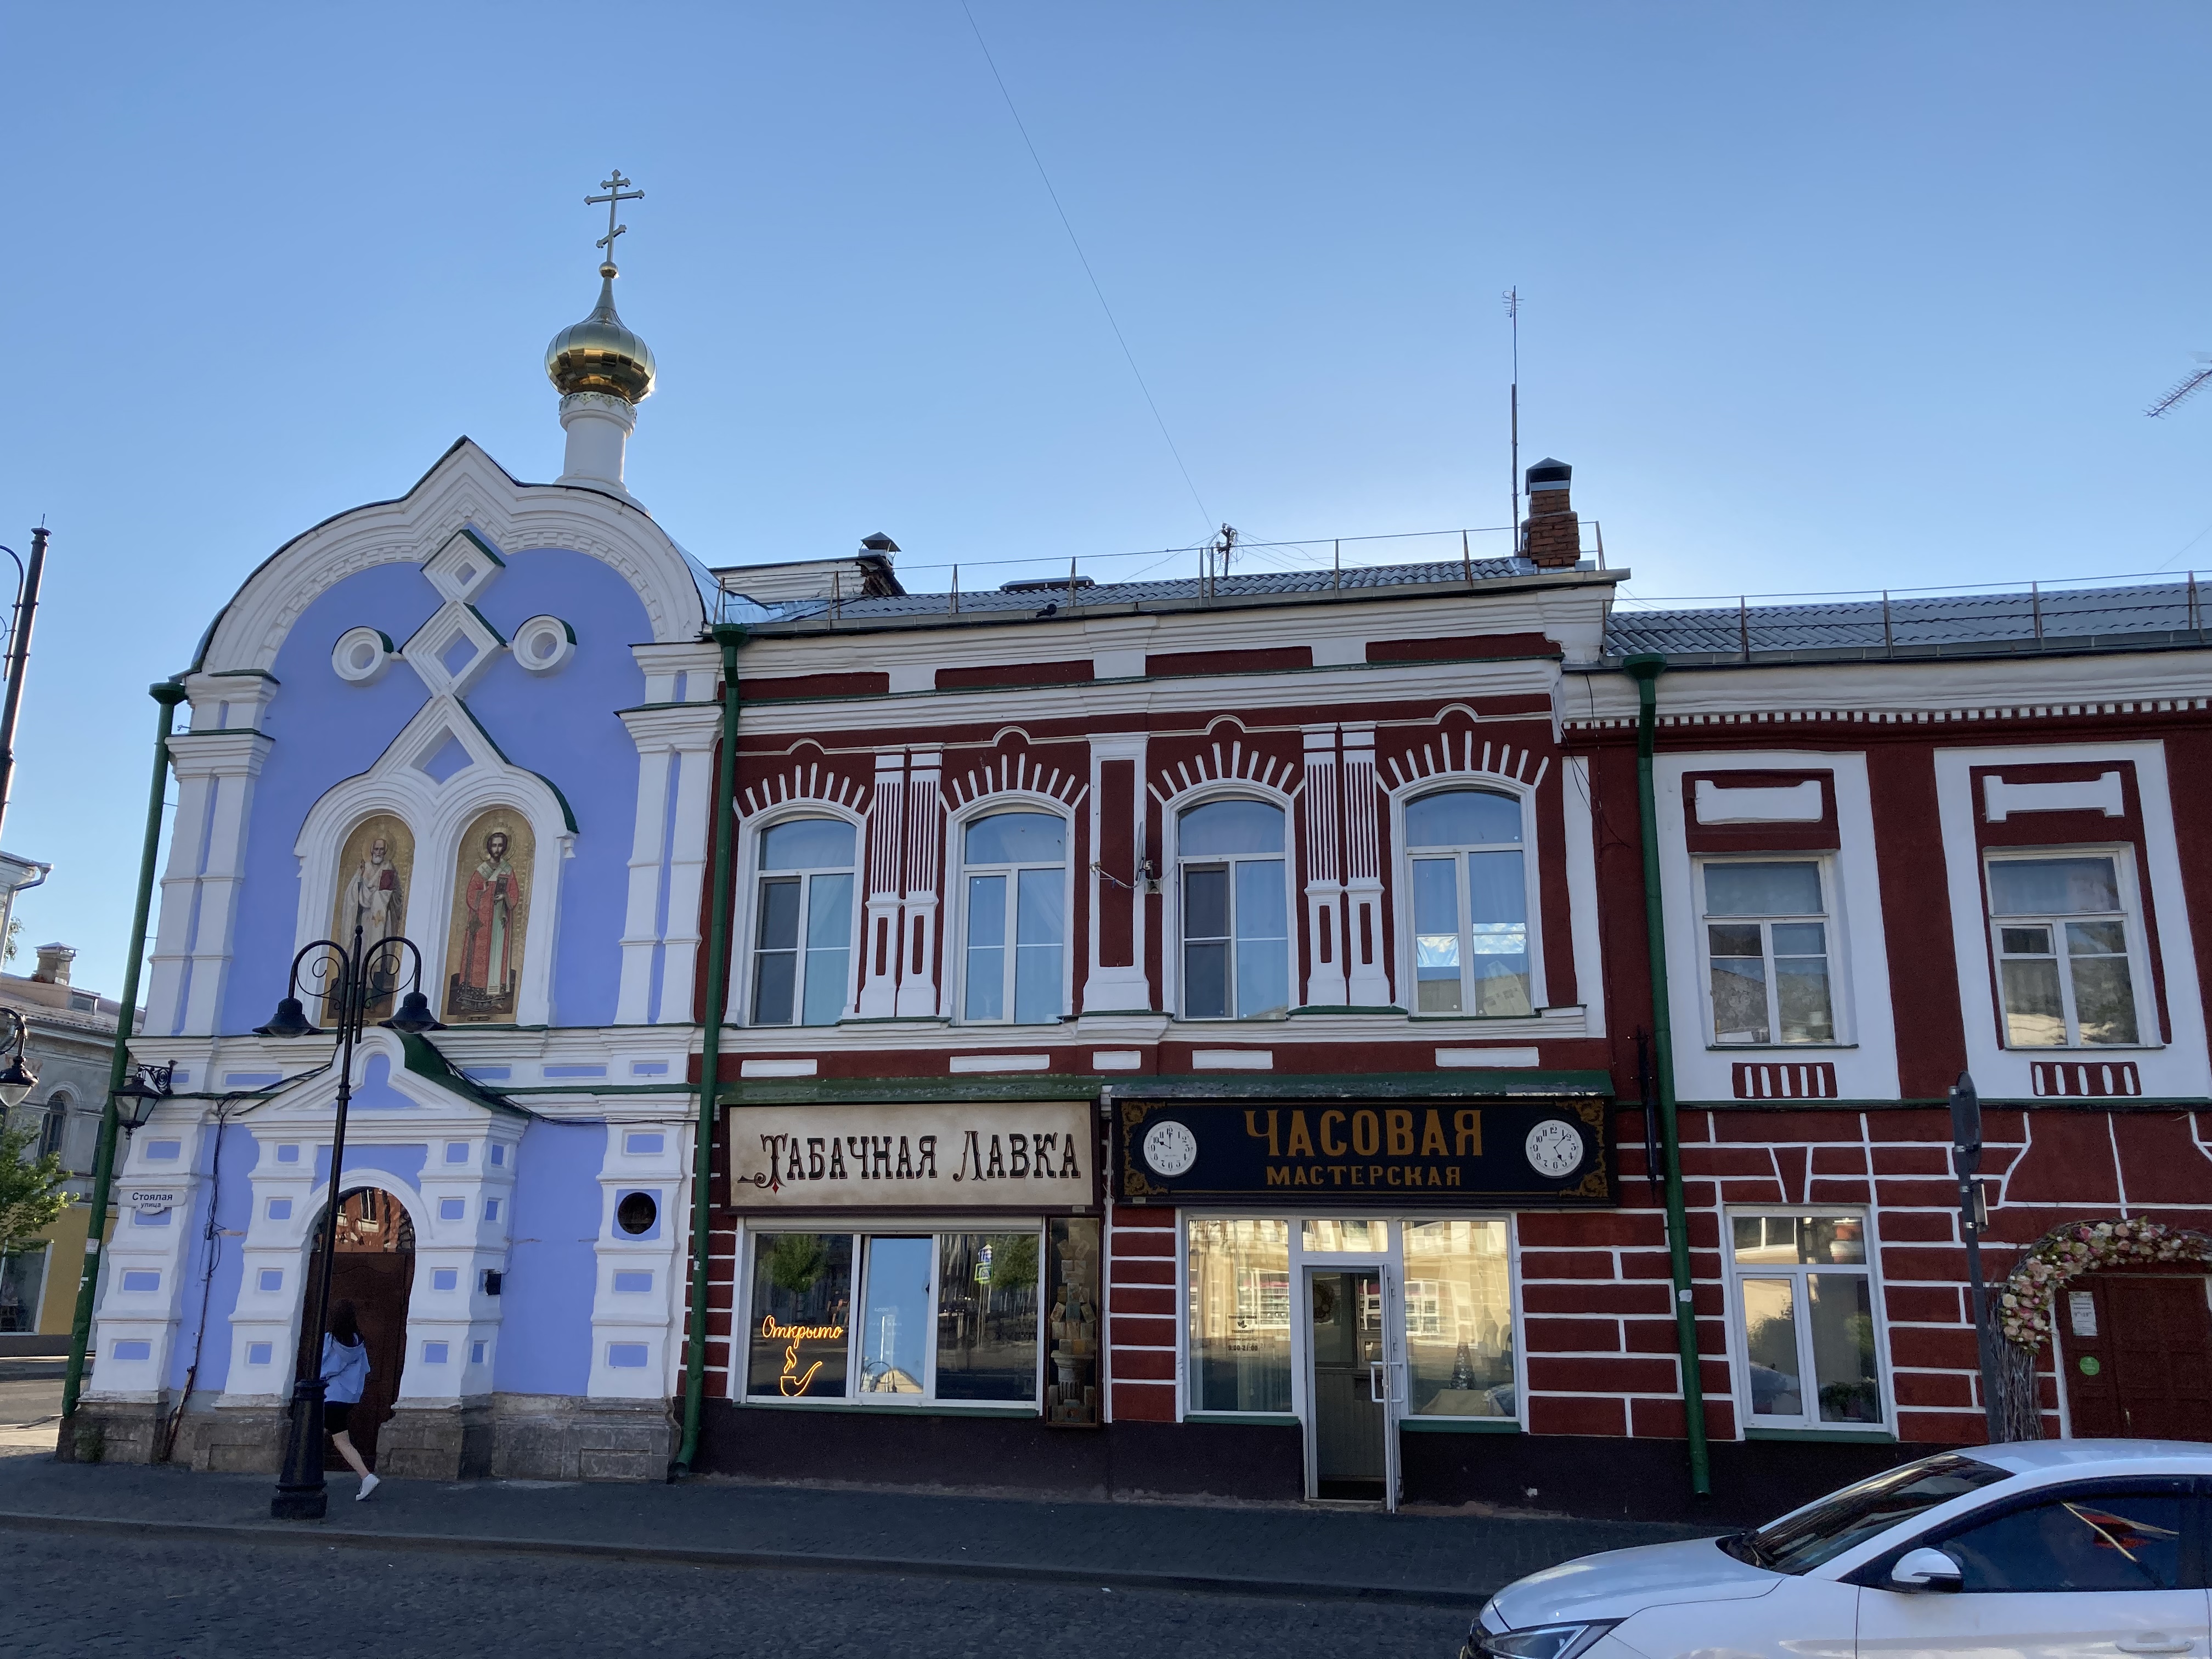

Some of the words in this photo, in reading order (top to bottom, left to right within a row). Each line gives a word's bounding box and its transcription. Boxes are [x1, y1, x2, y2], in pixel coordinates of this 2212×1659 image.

[1244, 1109, 1483, 1156] ЧАСОВАЯ
[1150, 1144, 1155, 1152] 9
[1185, 1144, 1190, 1152] 3
[1533, 1144, 1538, 1152] 9
[1571, 1143, 1576, 1151] 3
[738, 1133, 937, 1189] ТАБАЧНАЯ
[952, 1131, 1081, 1182] ЛАВКА
[1154, 1153, 1158, 1161] 8
[1266, 1166, 1460, 1186] МАСТЕРСКАЯ
[132, 1192, 173, 1200] Стоялая
[762, 1314, 844, 1350] Открыто
